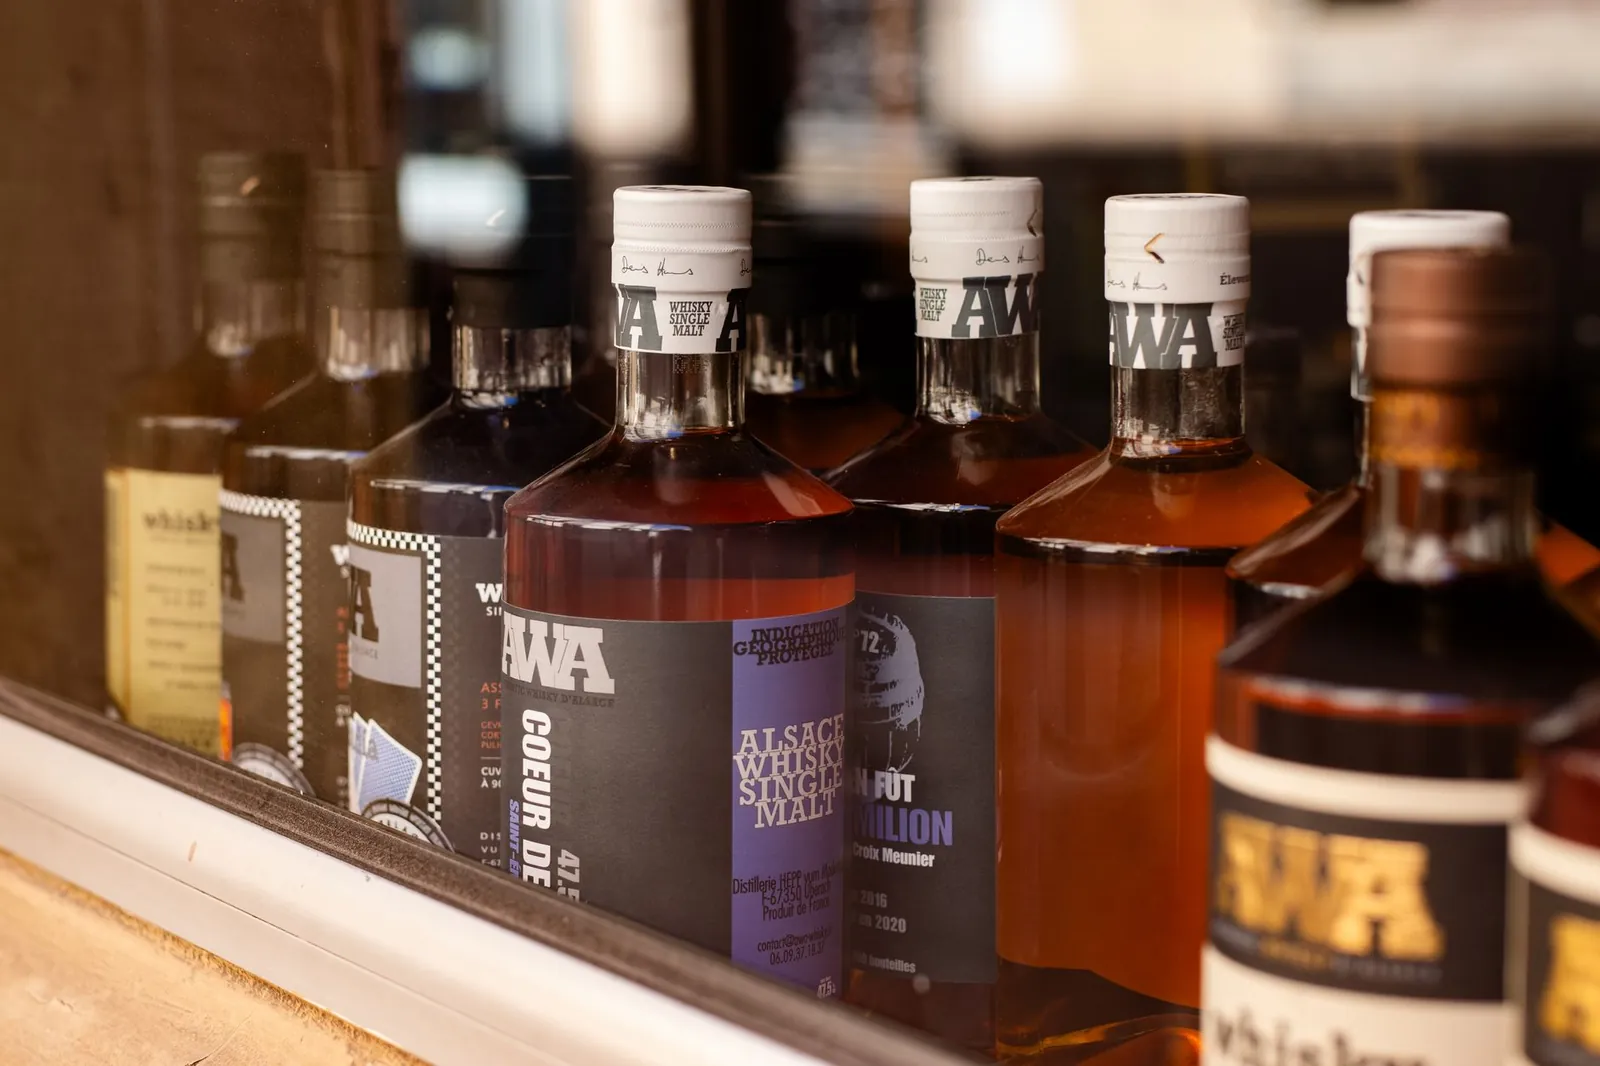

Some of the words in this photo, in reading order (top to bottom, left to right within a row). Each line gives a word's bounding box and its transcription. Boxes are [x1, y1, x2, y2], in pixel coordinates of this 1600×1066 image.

[919, 287, 948, 300] WHISKY
[669, 301, 713, 313] WHISKY
[919, 299, 946, 311] SINGLE
[669, 313, 710, 325] SINGLE
[921, 310, 941, 322] MALT
[672, 324, 705, 337] MALT
[751, 617, 839, 643] INDICATION
[501, 610, 615, 694] AWA
[736, 713, 844, 756] ALSACE
[733, 735, 844, 780] WHISKY
[522, 709, 551, 830] COEUR
[739, 762, 843, 806] SINGLE
[874, 766, 915, 803] FÛT
[754, 787, 836, 828] MALT
[522, 839, 551, 888] DE
[882, 847, 935, 868] Meunier
[733, 877, 777, 894] Distillerie
[860, 889, 887, 908] 2016
[763, 901, 795, 921] Produit
[797, 901, 807, 916] de
[875, 914, 907, 934] 2020
